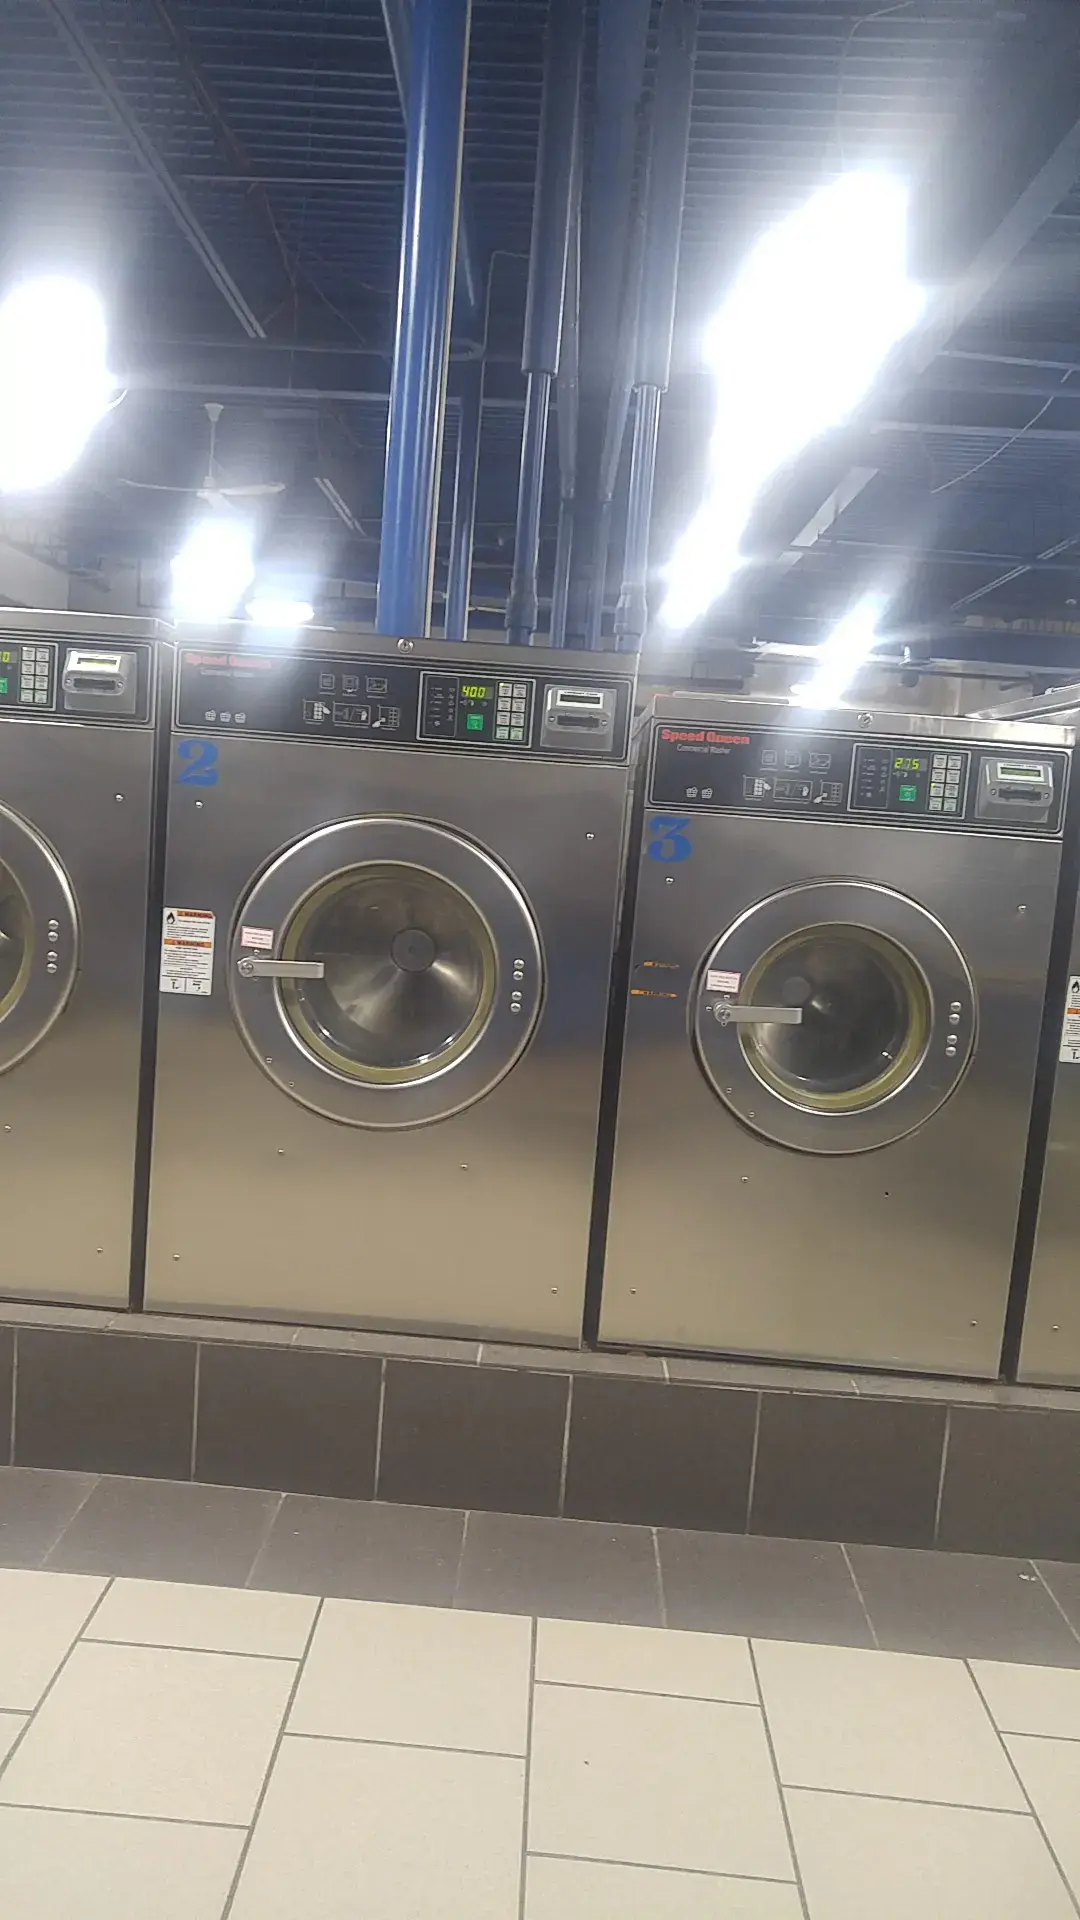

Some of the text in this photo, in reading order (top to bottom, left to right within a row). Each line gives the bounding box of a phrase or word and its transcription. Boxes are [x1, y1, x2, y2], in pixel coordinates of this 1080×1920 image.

[462, 685, 486, 698] 400
[661, 728, 750, 745] Speed Queen
[177, 739, 218, 787] 2
[894, 757, 919, 770] 275
[648, 814, 692, 863] 3
